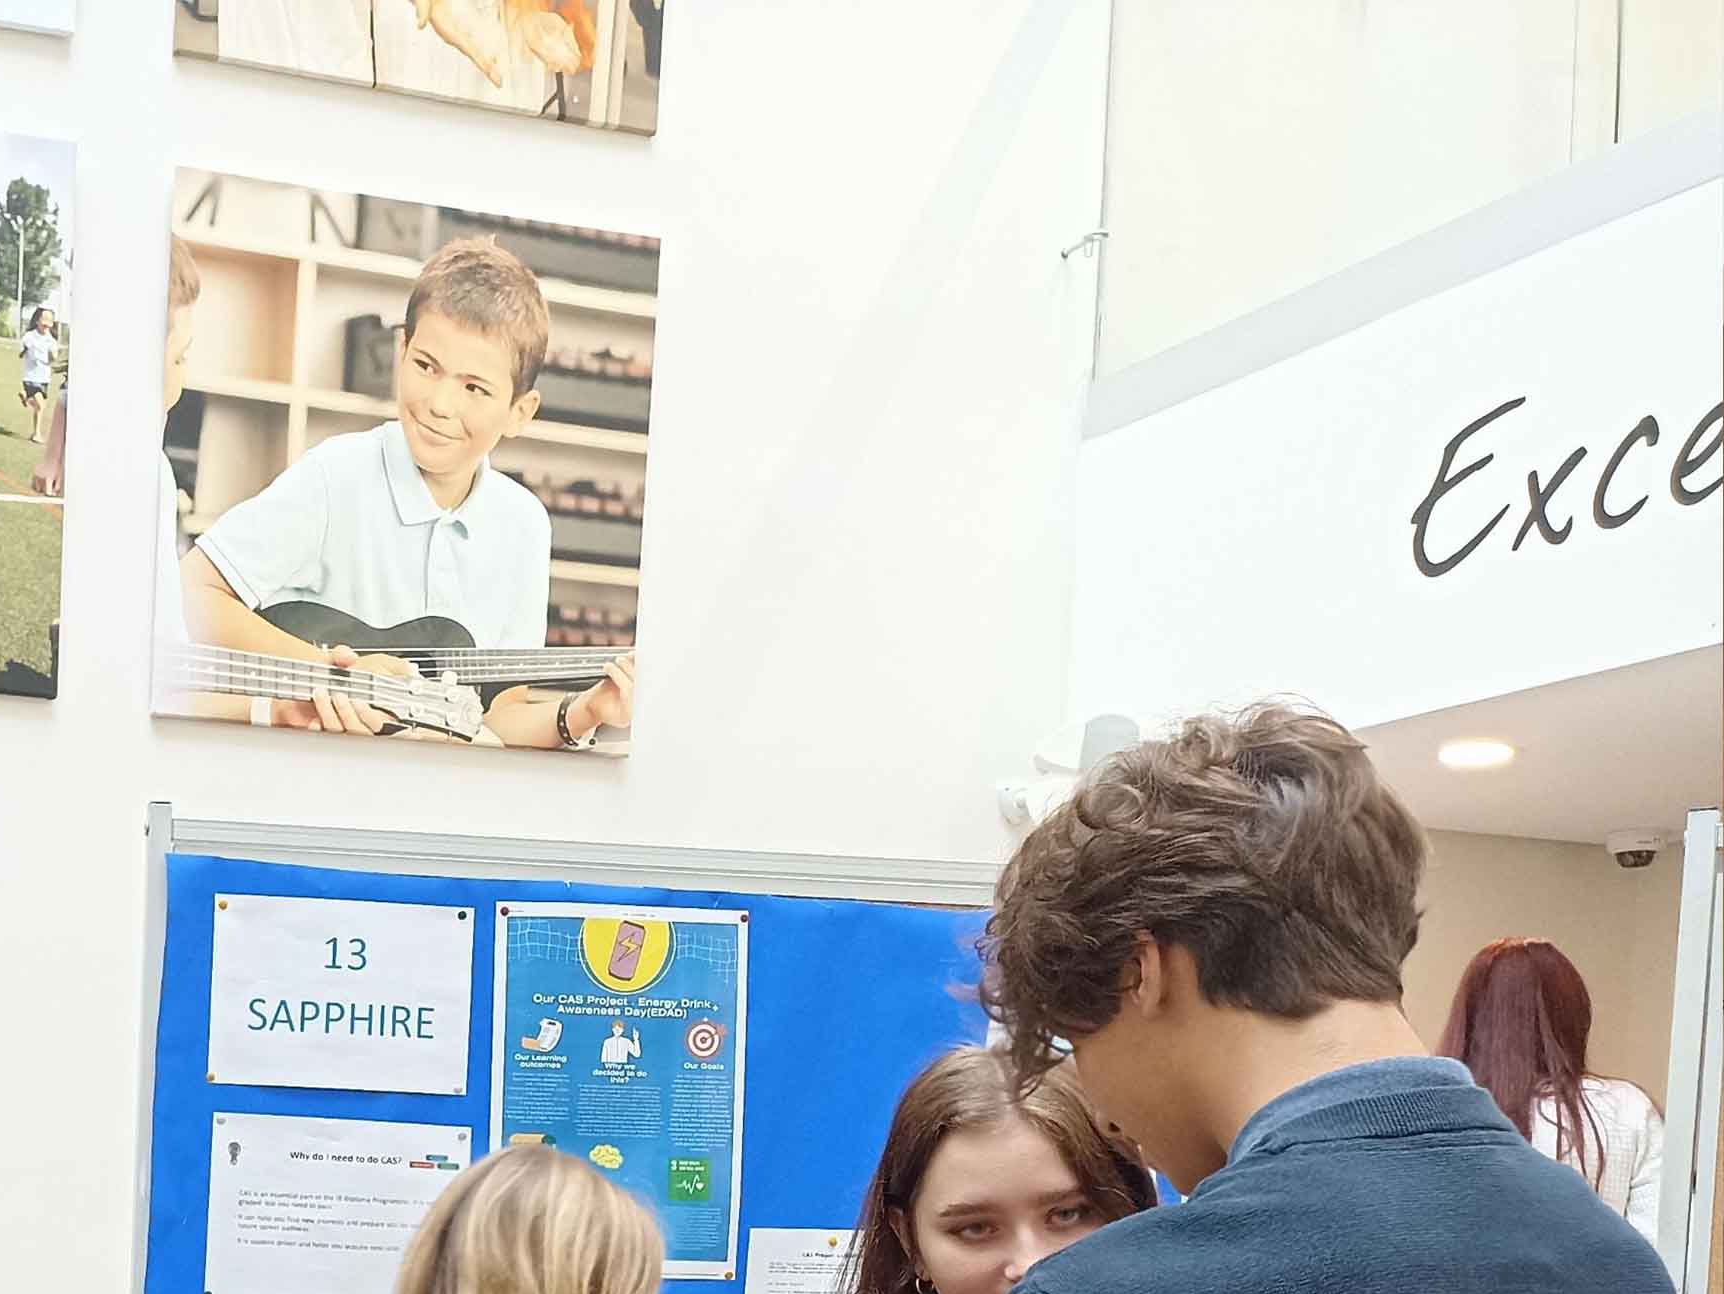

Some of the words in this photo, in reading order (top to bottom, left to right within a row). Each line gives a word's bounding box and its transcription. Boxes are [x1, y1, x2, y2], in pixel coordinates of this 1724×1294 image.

[1410, 395, 1723, 578] Exce
[324, 936, 368, 970] 13
[532, 993, 556, 1003] Our
[558, 994, 583, 1005] CAS
[587, 995, 628, 1007] Project
[638, 997, 678, 1009] Energy
[681, 998, 712, 1009] Drink
[557, 1004, 621, 1015] Awareness
[247, 998, 436, 1039] SAPPHIRE
[531, 1055, 567, 1063] Learning
[683, 1062, 699, 1070] Our
[290, 1151, 310, 1161] Why
[312, 1152, 324, 1161] do
[331, 1154, 354, 1163] need
[367, 1156, 379, 1164] do
[380, 1156, 403, 1166] CAS?
